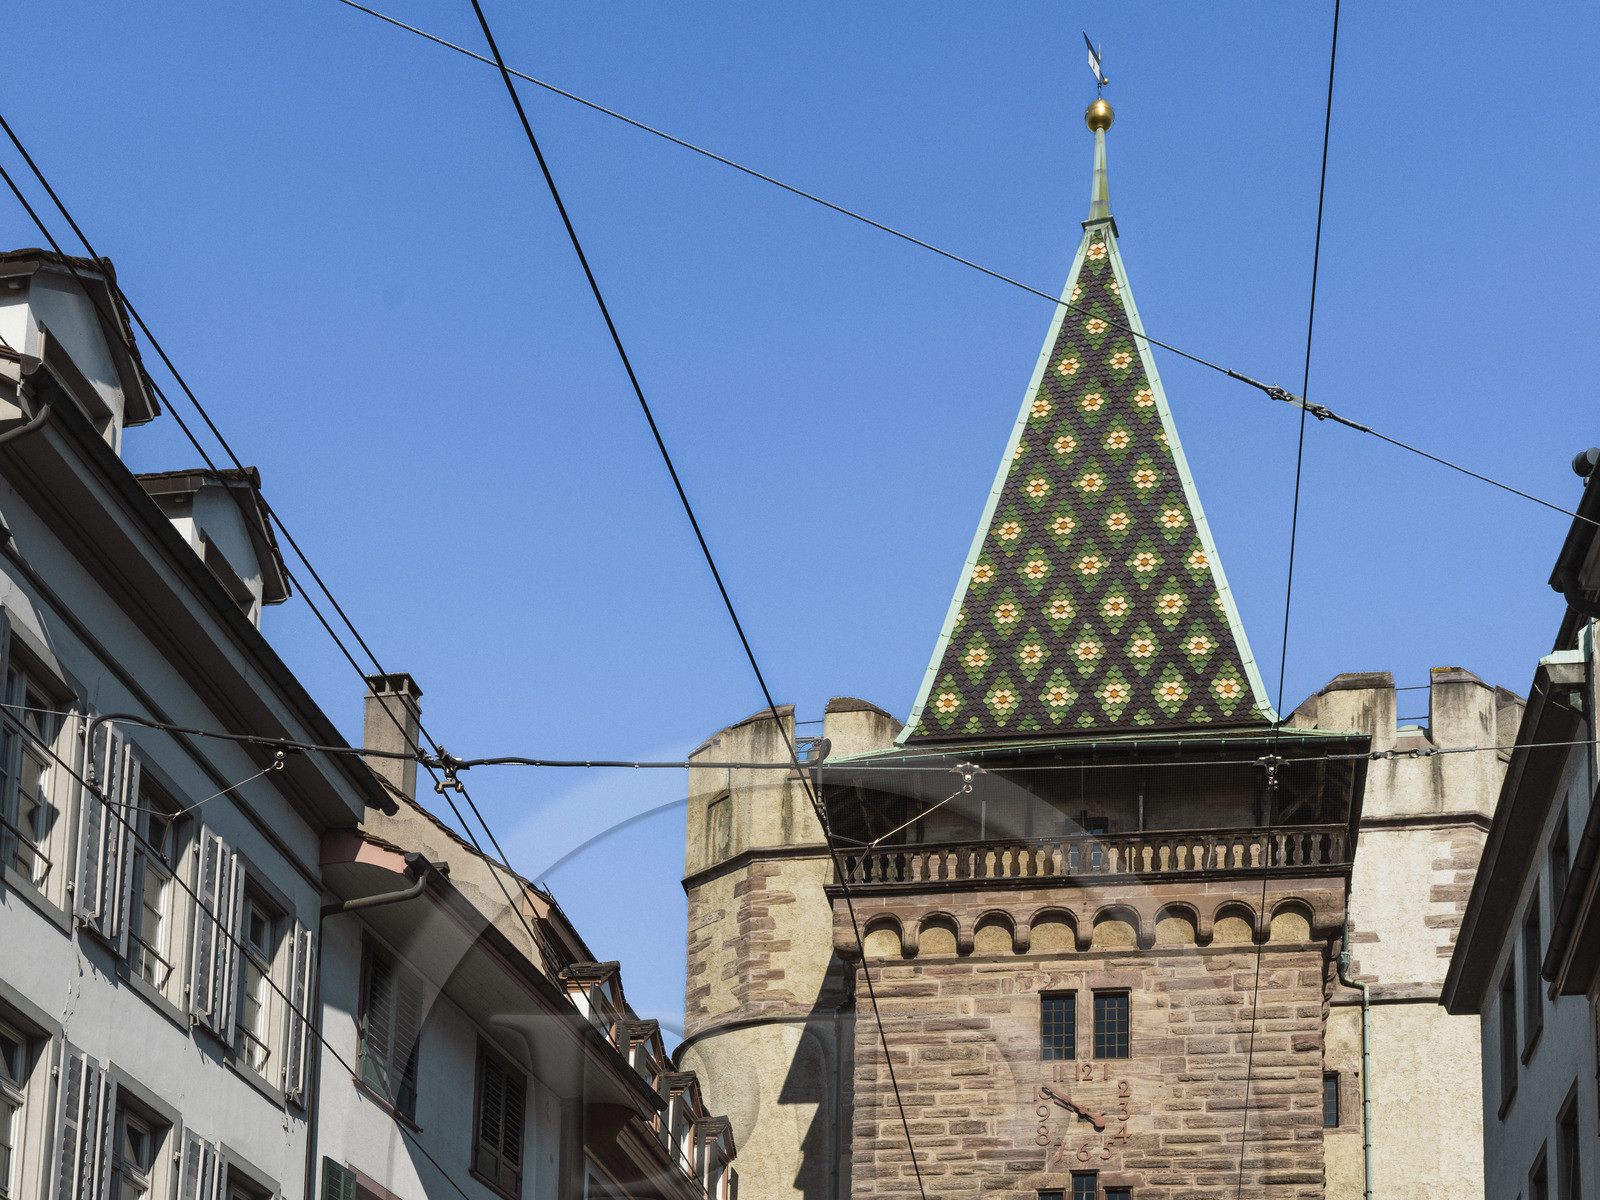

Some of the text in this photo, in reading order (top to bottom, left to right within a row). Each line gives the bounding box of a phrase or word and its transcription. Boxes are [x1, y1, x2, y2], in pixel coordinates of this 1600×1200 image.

[1053, 1064, 1064, 1082] 11
[1075, 1063, 1093, 1081] 12
[1103, 1063, 1108, 1081] 1
[1033, 1083, 1052, 1102] 10
[1117, 1079, 1130, 1098] 2
[1036, 1105, 1050, 1122] 9
[1118, 1101, 1130, 1121] 3
[1035, 1123, 1051, 1146] 8
[1114, 1122, 1132, 1144] 4
[1054, 1142, 1066, 1163] 7
[1076, 1143, 1092, 1162] 6
[1099, 1139, 1115, 1161] 5
